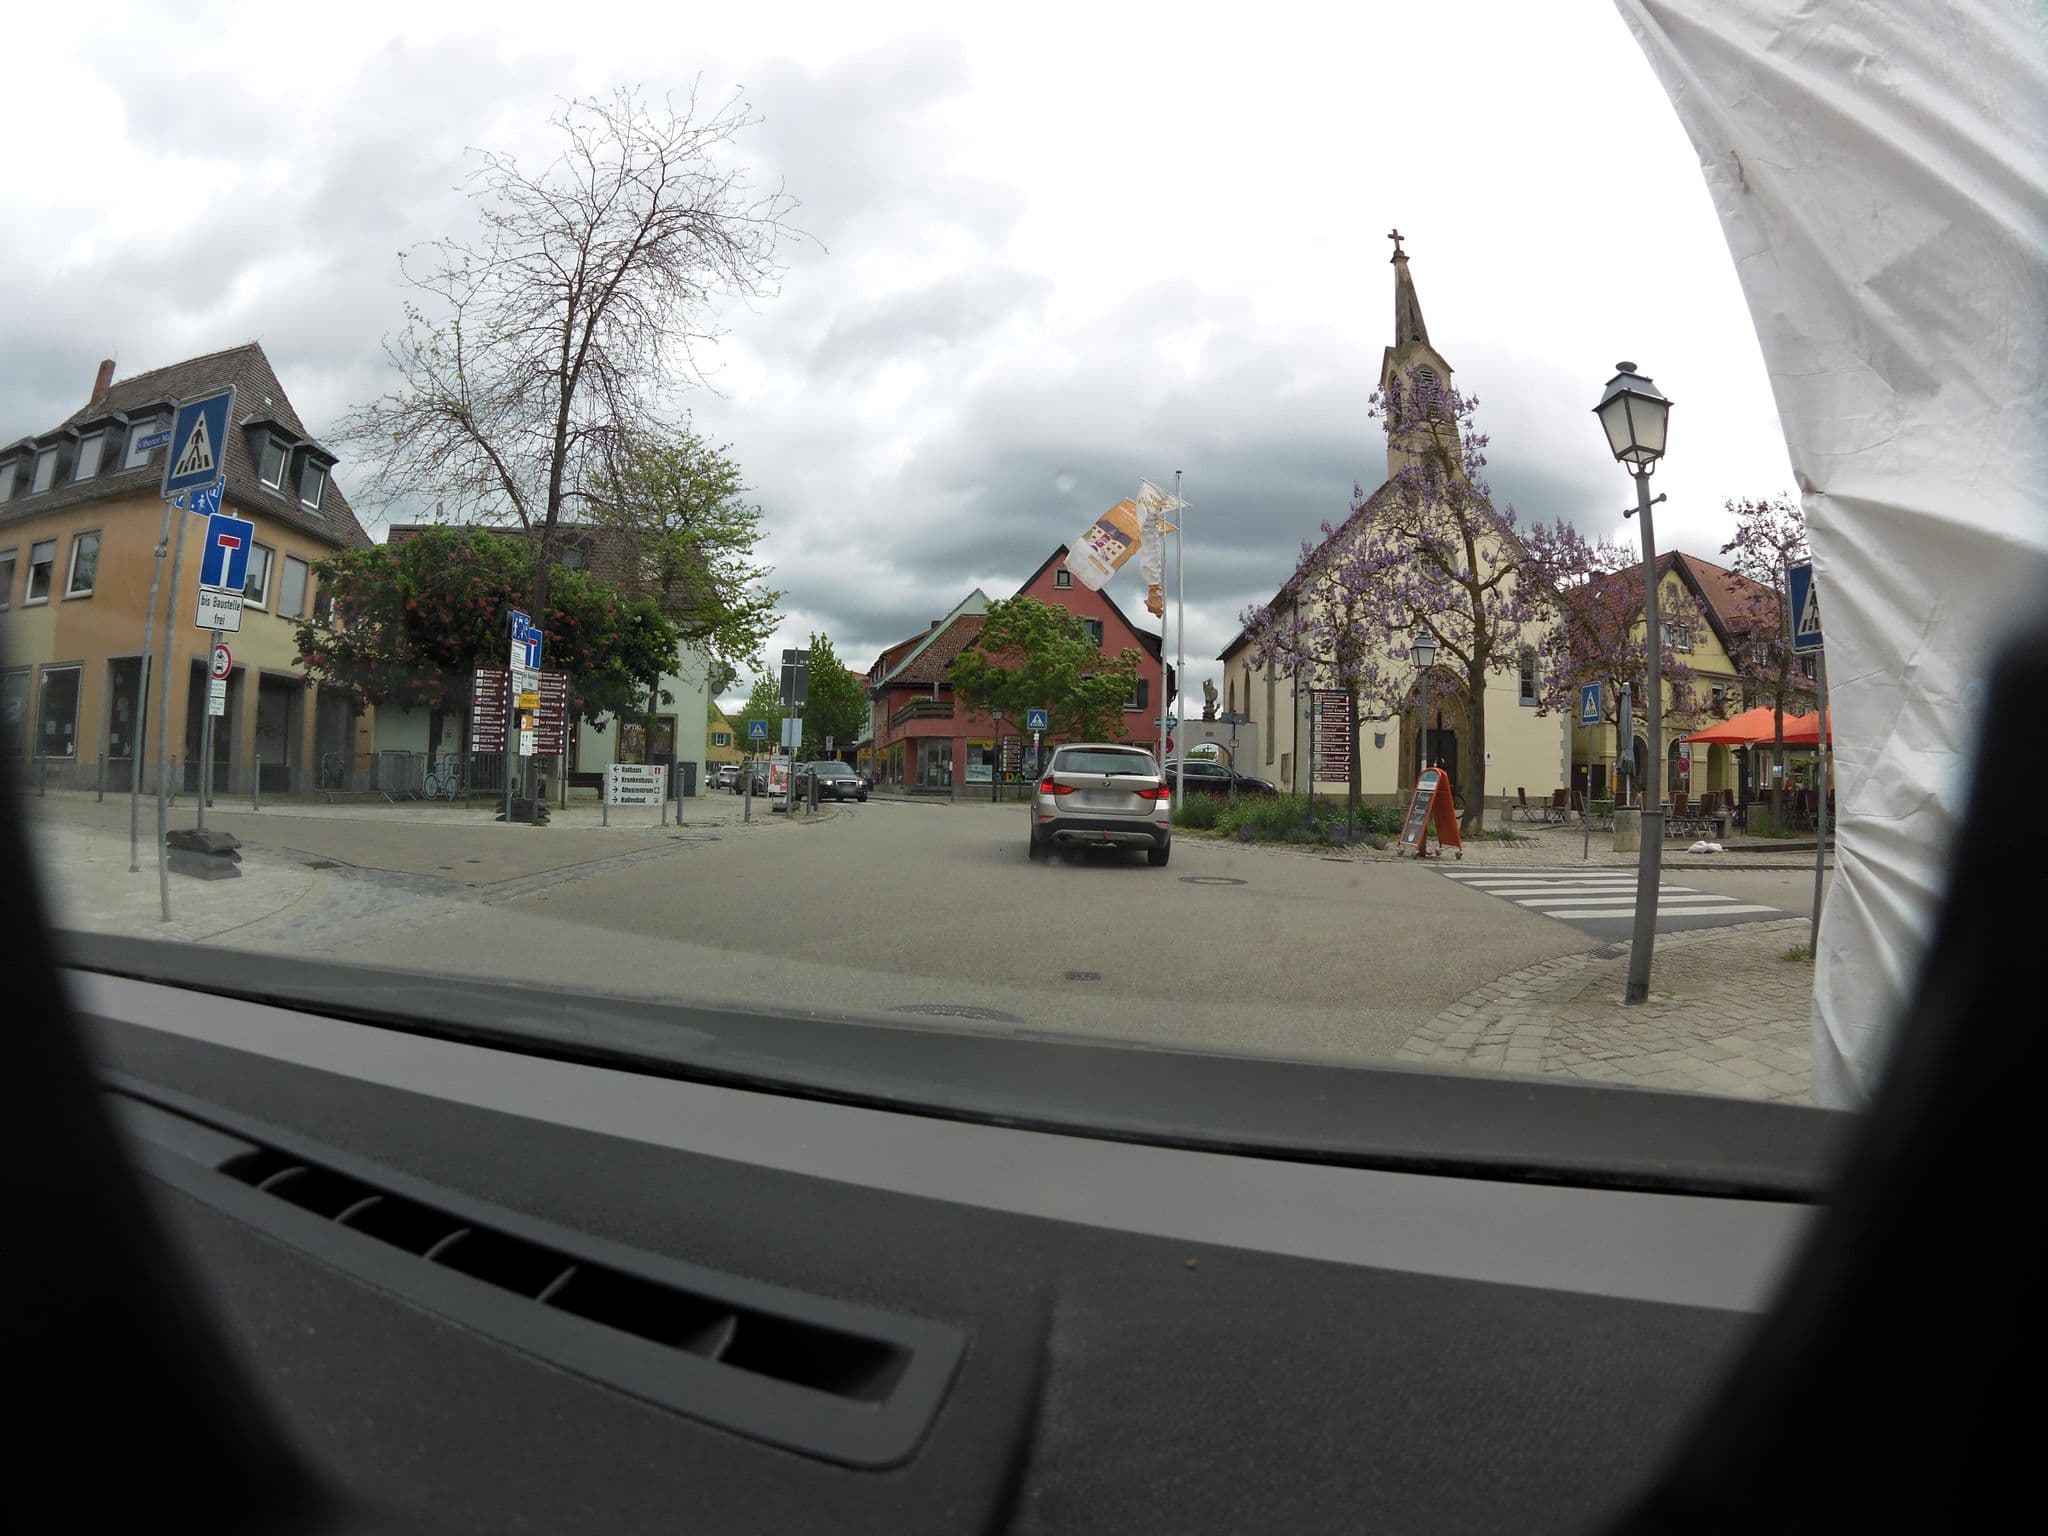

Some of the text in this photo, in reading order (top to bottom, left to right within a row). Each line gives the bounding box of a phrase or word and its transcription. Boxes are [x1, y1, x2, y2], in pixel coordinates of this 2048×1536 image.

[201, 594, 241, 611] bis Baustelle
[214, 613, 225, 625] frei
[621, 776, 654, 784] Krankenhaus
